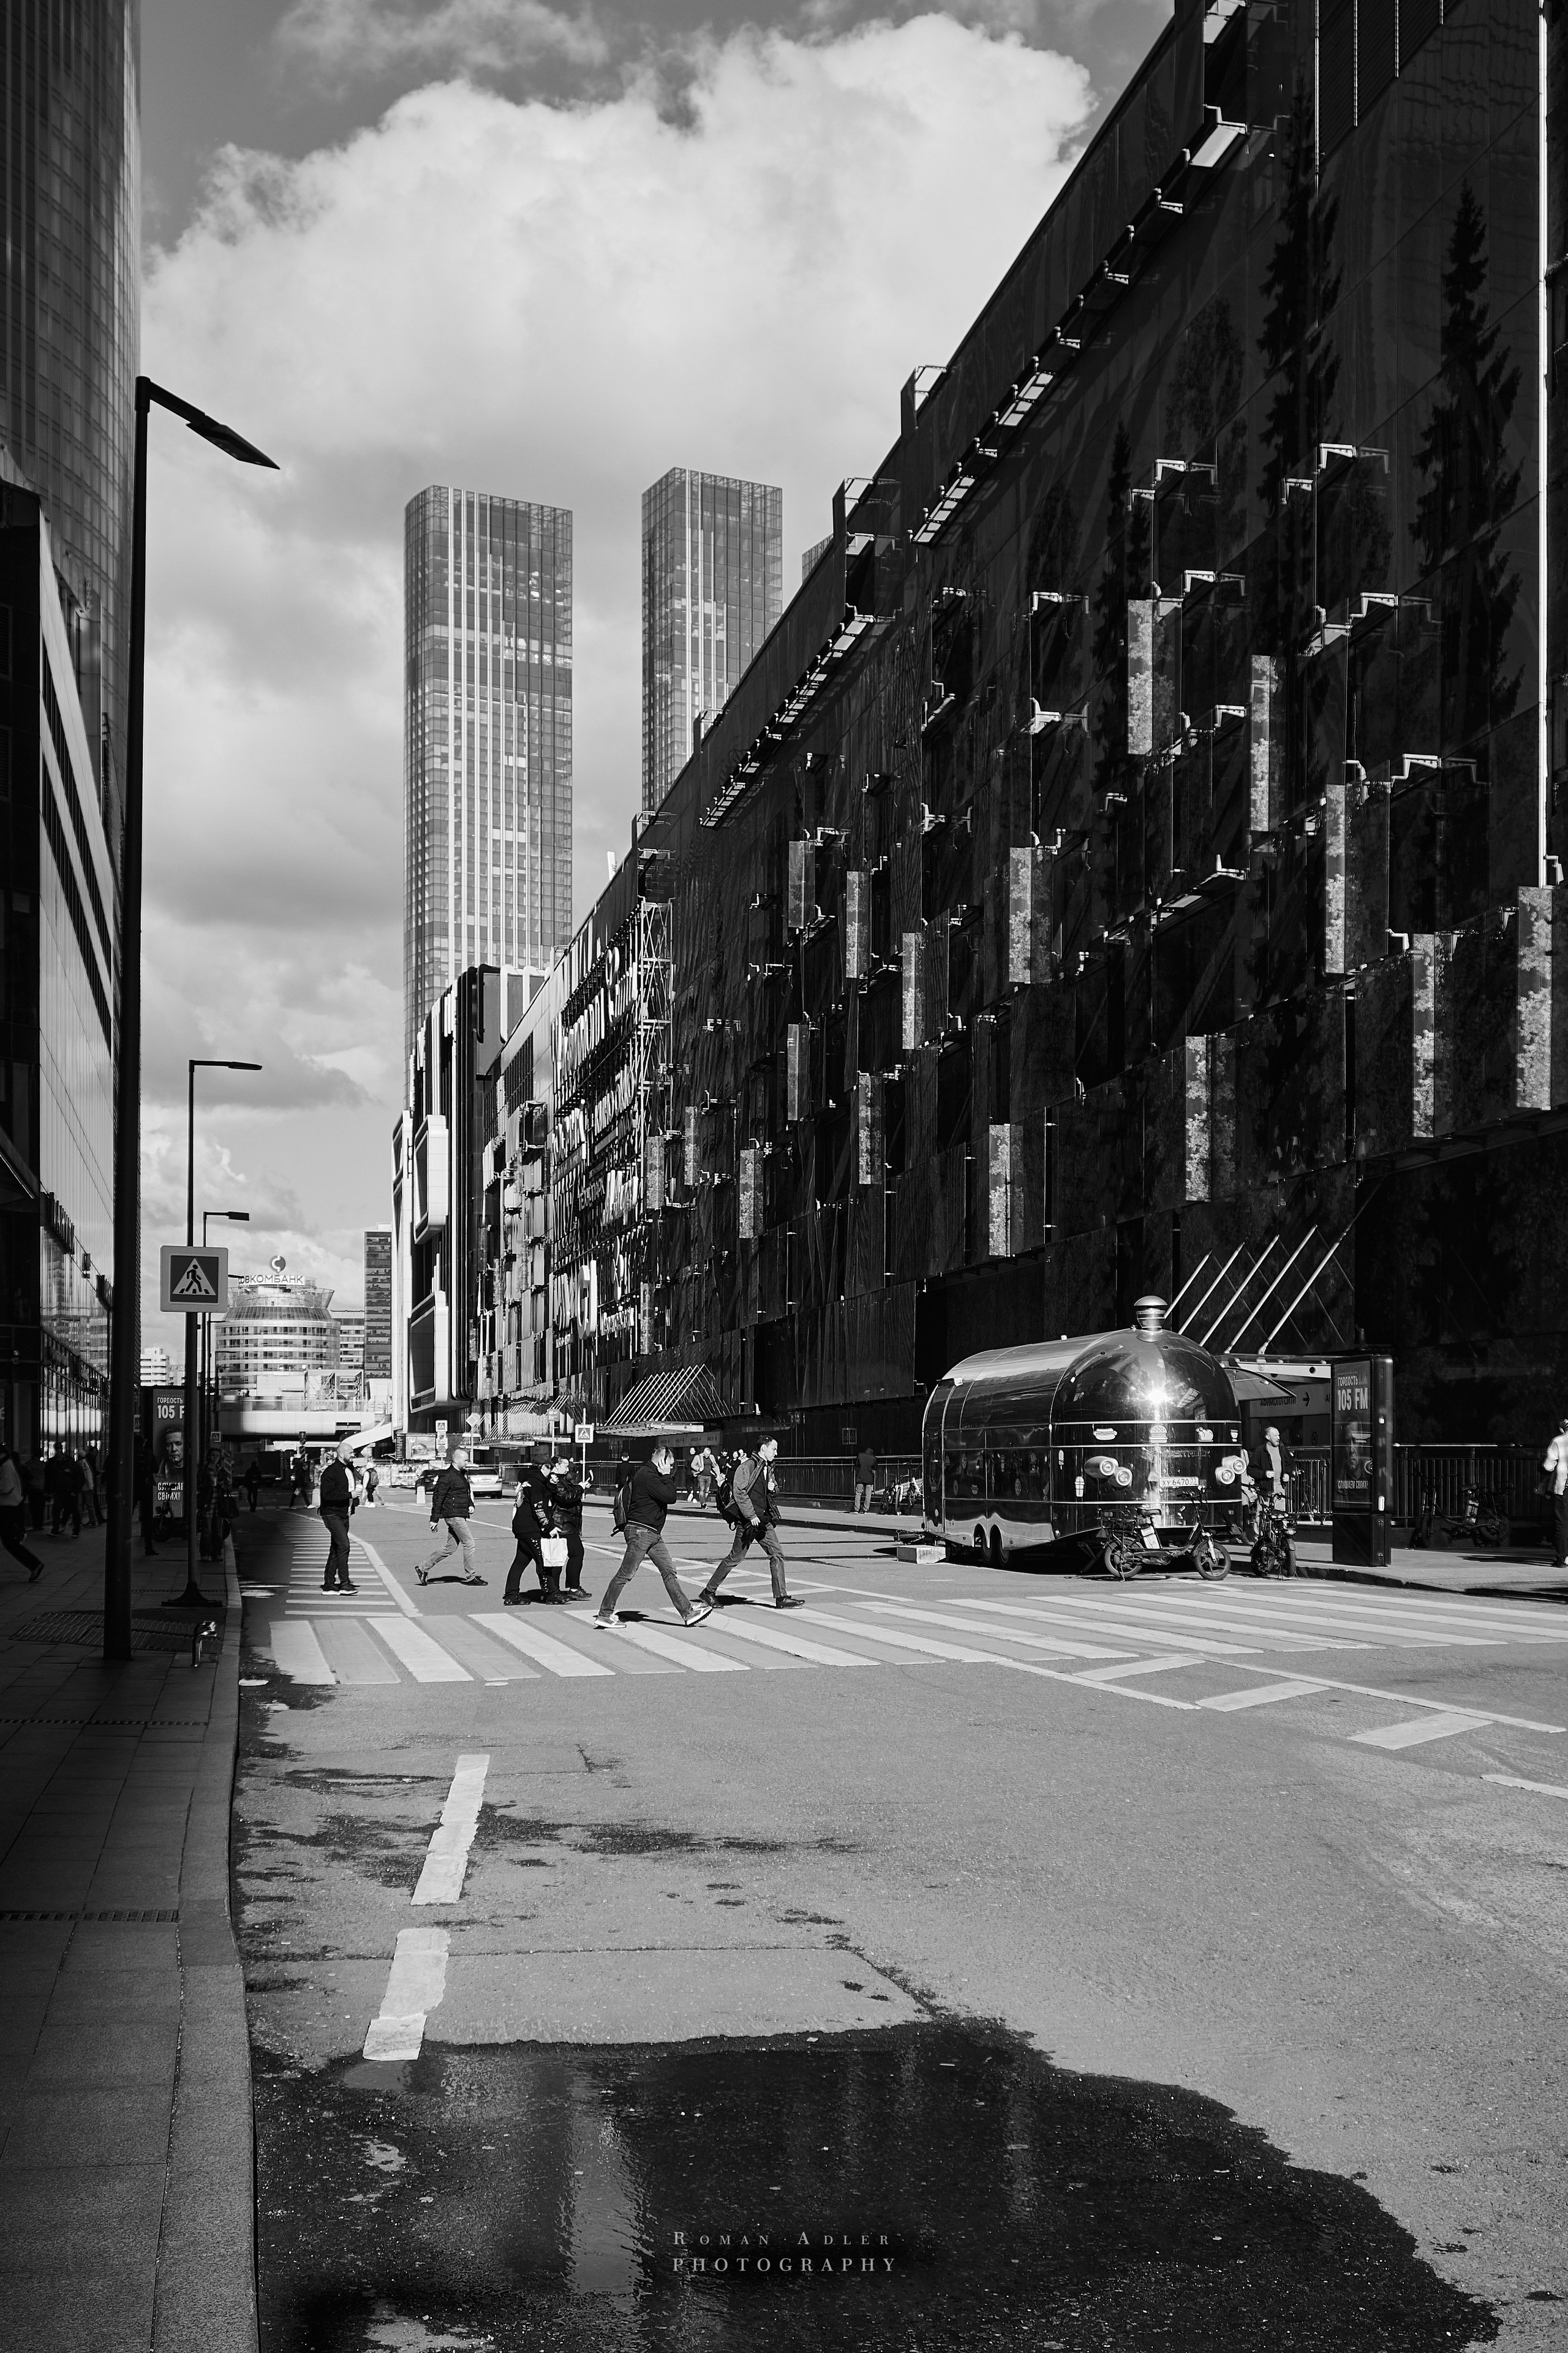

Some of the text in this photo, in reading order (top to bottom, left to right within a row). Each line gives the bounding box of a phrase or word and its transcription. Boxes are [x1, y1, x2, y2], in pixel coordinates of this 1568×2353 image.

[1338, 1376, 1359, 1387] ГОРДОСТЬ
[1338, 1389, 1352, 1411] 105
[1355, 1388, 1368, 1410] FM
[157, 1405, 185, 1419] 105 F
